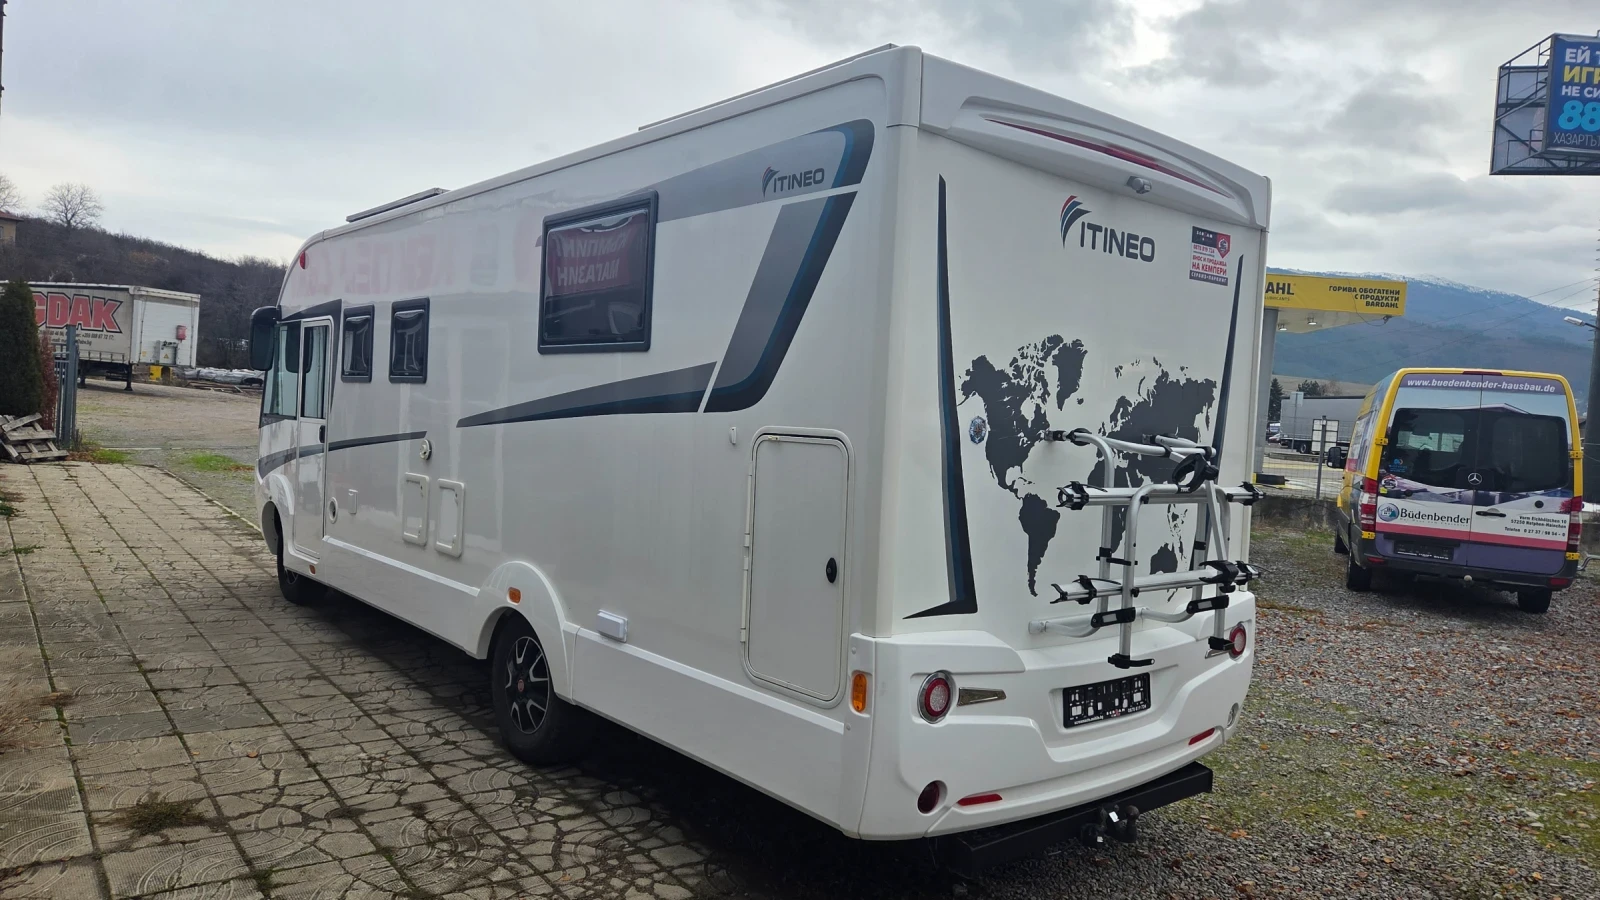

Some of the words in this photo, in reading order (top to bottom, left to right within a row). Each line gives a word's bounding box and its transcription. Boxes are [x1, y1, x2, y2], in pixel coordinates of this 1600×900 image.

[1565, 46, 1591, 64] ЕЙ
[1561, 85, 1580, 97] НЕ
[773, 167, 825, 193] ITINEO
[1080, 221, 1155, 262] ITINEO
[1192, 262, 1201, 271] НА
[1202, 264, 1227, 276] КЕМПЕРИ
[1329, 285, 1357, 293] ГОРИВА
[1359, 287, 1400, 296] ОБОГАТЕНИ
[1359, 294, 1400, 302] ПРОДУКТИ
[1365, 301, 1399, 309] BARDAHL
[1407, 379, 1556, 393] www.buedenbender-hausbau.de
[1400, 508, 1471, 524] Büdenbender
